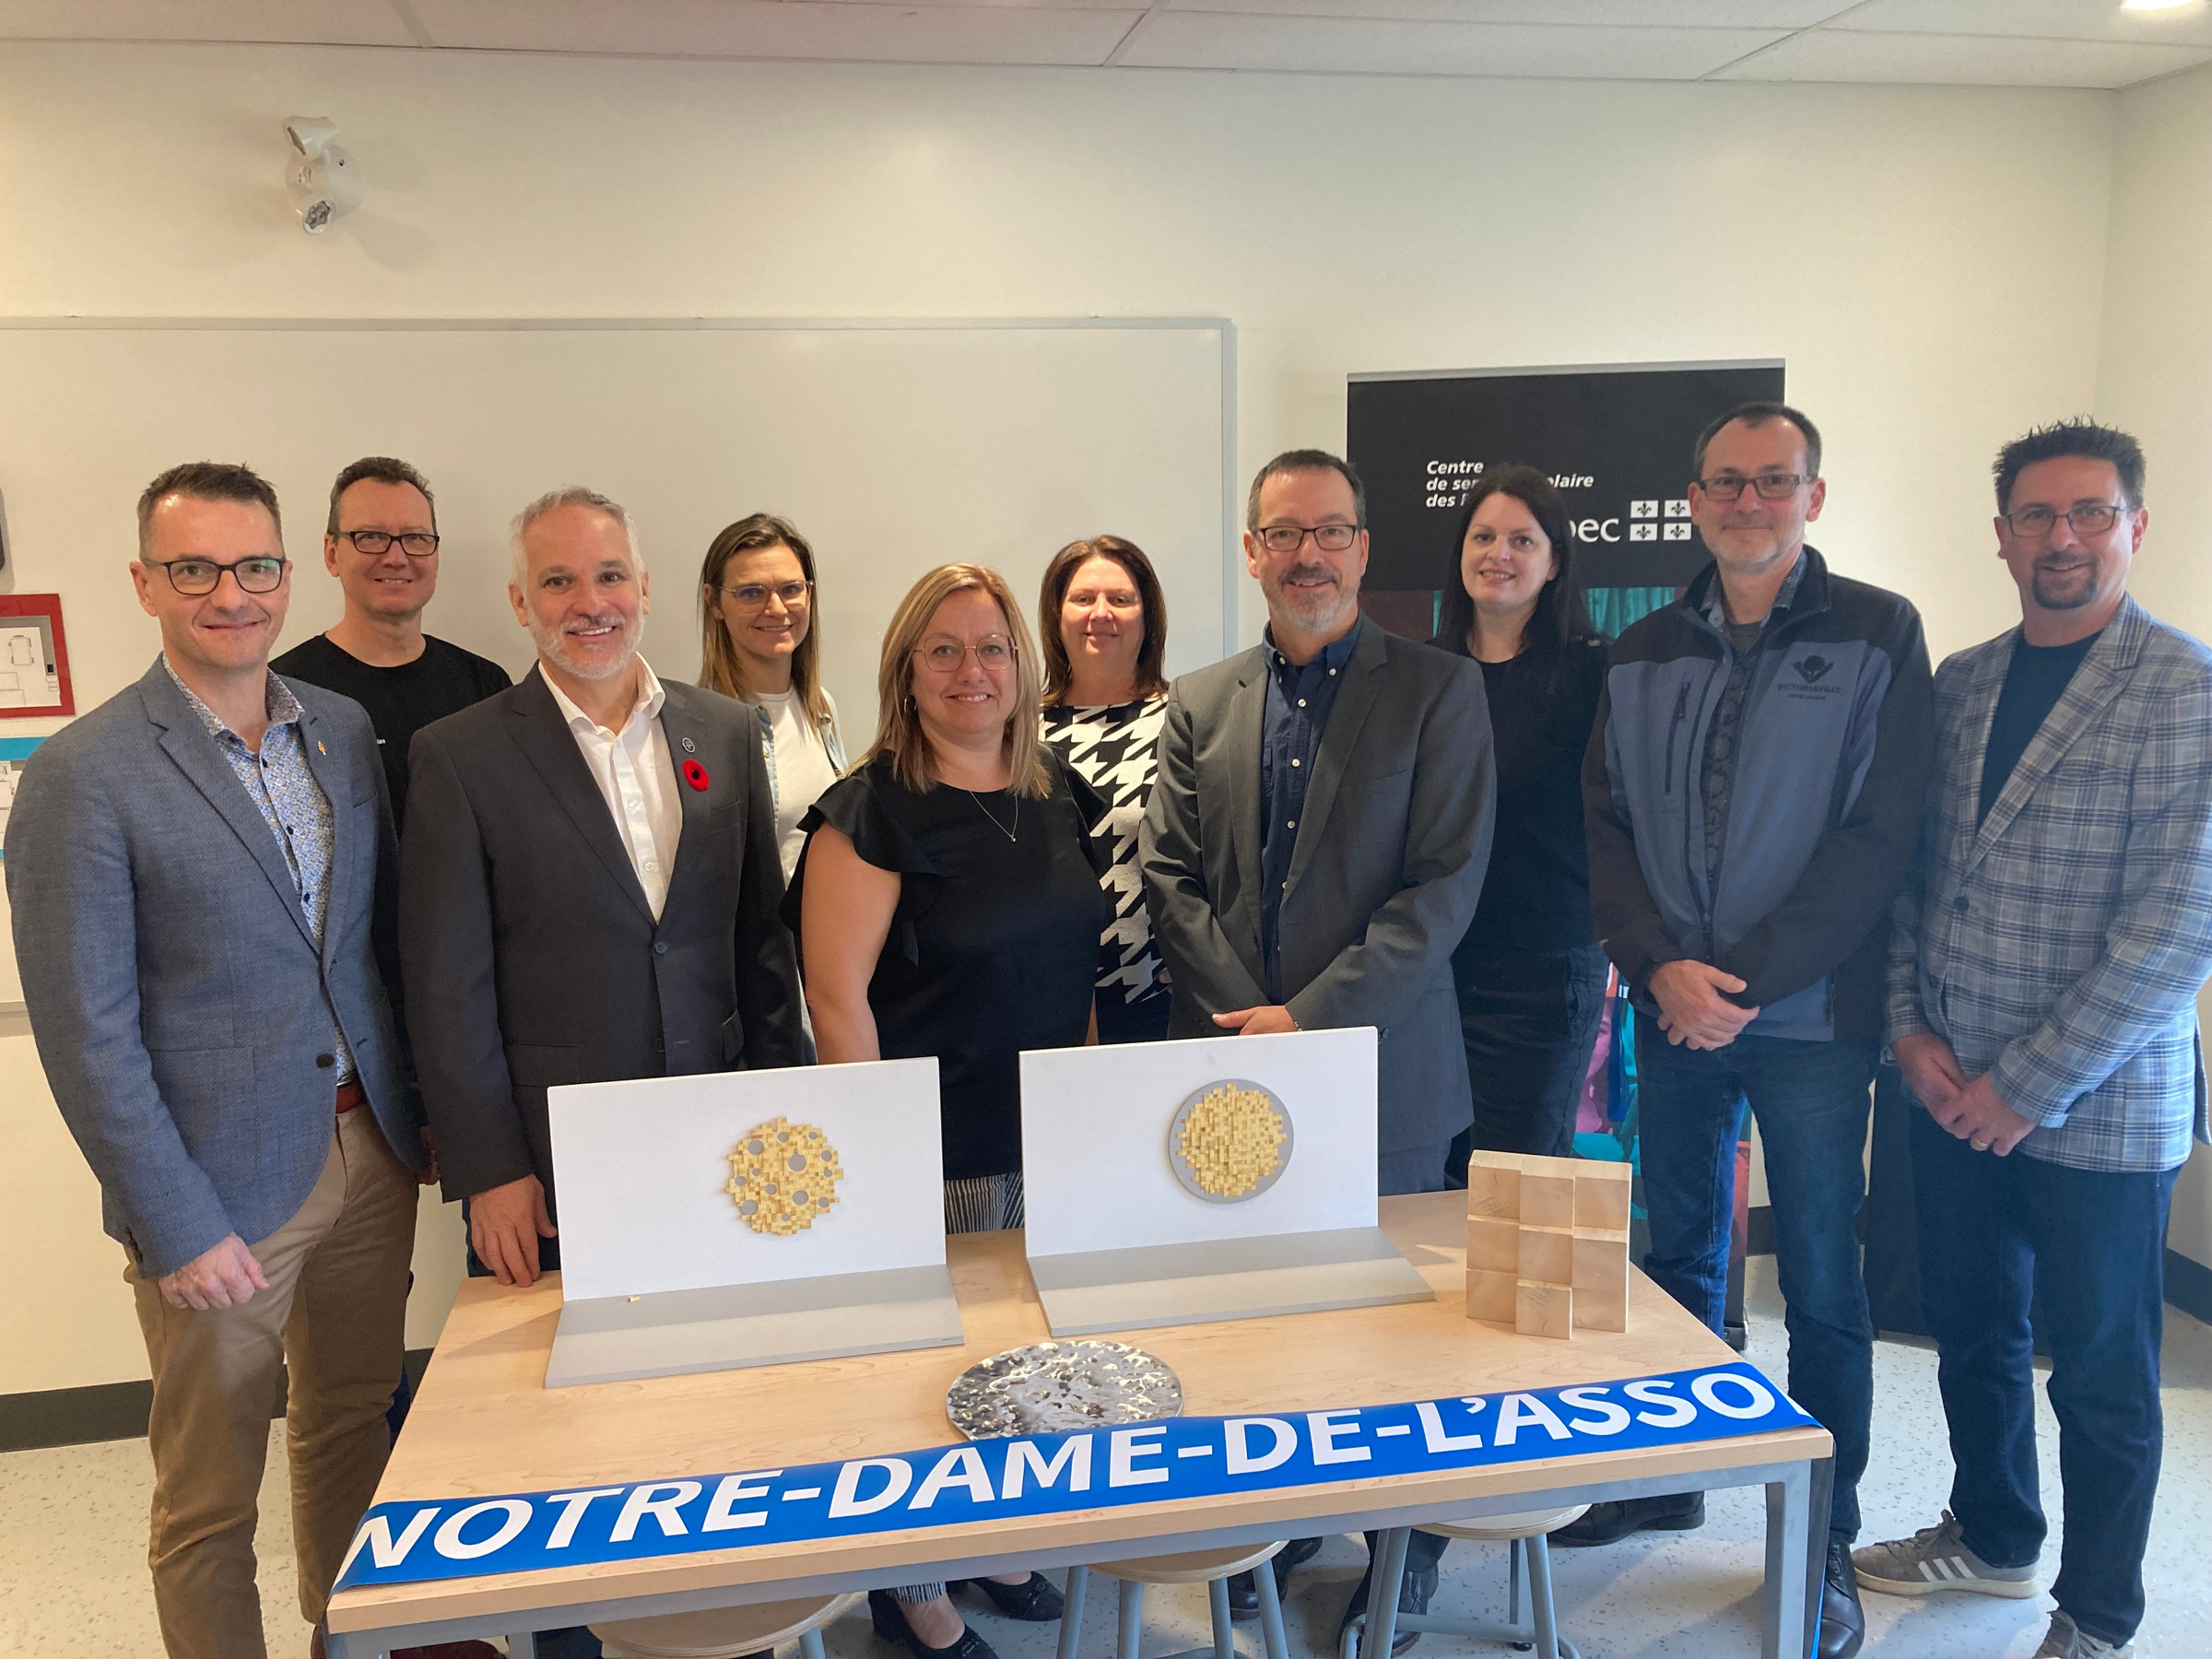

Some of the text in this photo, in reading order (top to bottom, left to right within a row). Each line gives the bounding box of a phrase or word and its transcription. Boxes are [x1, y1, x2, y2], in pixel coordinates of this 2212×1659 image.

[1427, 460, 1484, 475] Centre
[1426, 477, 1448, 490] de
[1452, 478, 1480, 490] ser
[1426, 493, 1456, 507] des
[333, 1372, 1813, 1591] NOTRE-DAME-DE-L’ASSO
